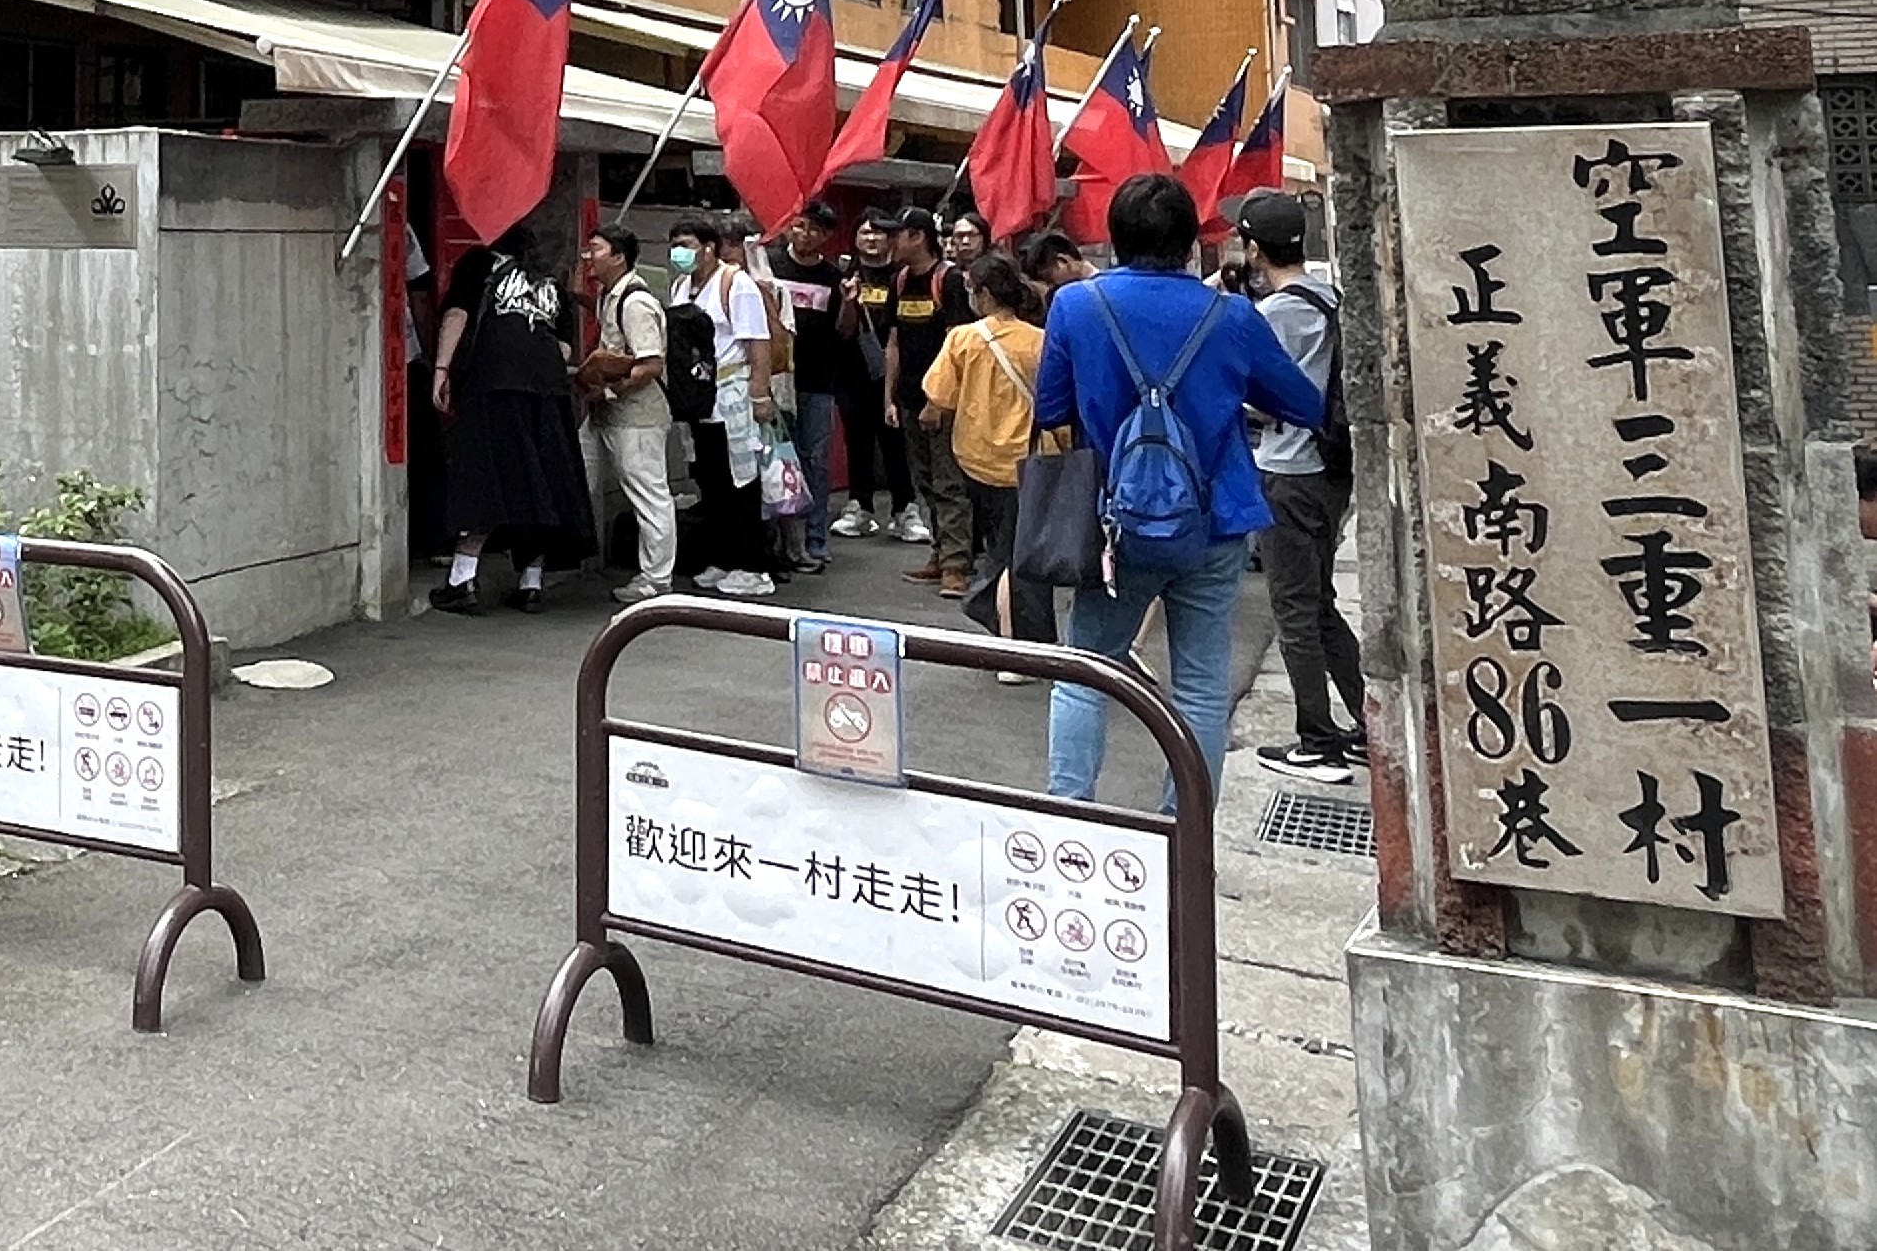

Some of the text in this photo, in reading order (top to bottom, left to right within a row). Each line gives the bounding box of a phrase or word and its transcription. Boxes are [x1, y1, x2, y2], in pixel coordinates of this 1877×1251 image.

[1446, 244, 1583, 870] 正義南路86巷
[1573, 138, 1741, 900] 空軍三重一村
[625, 815, 961, 923] 歡迎來一村走走!
